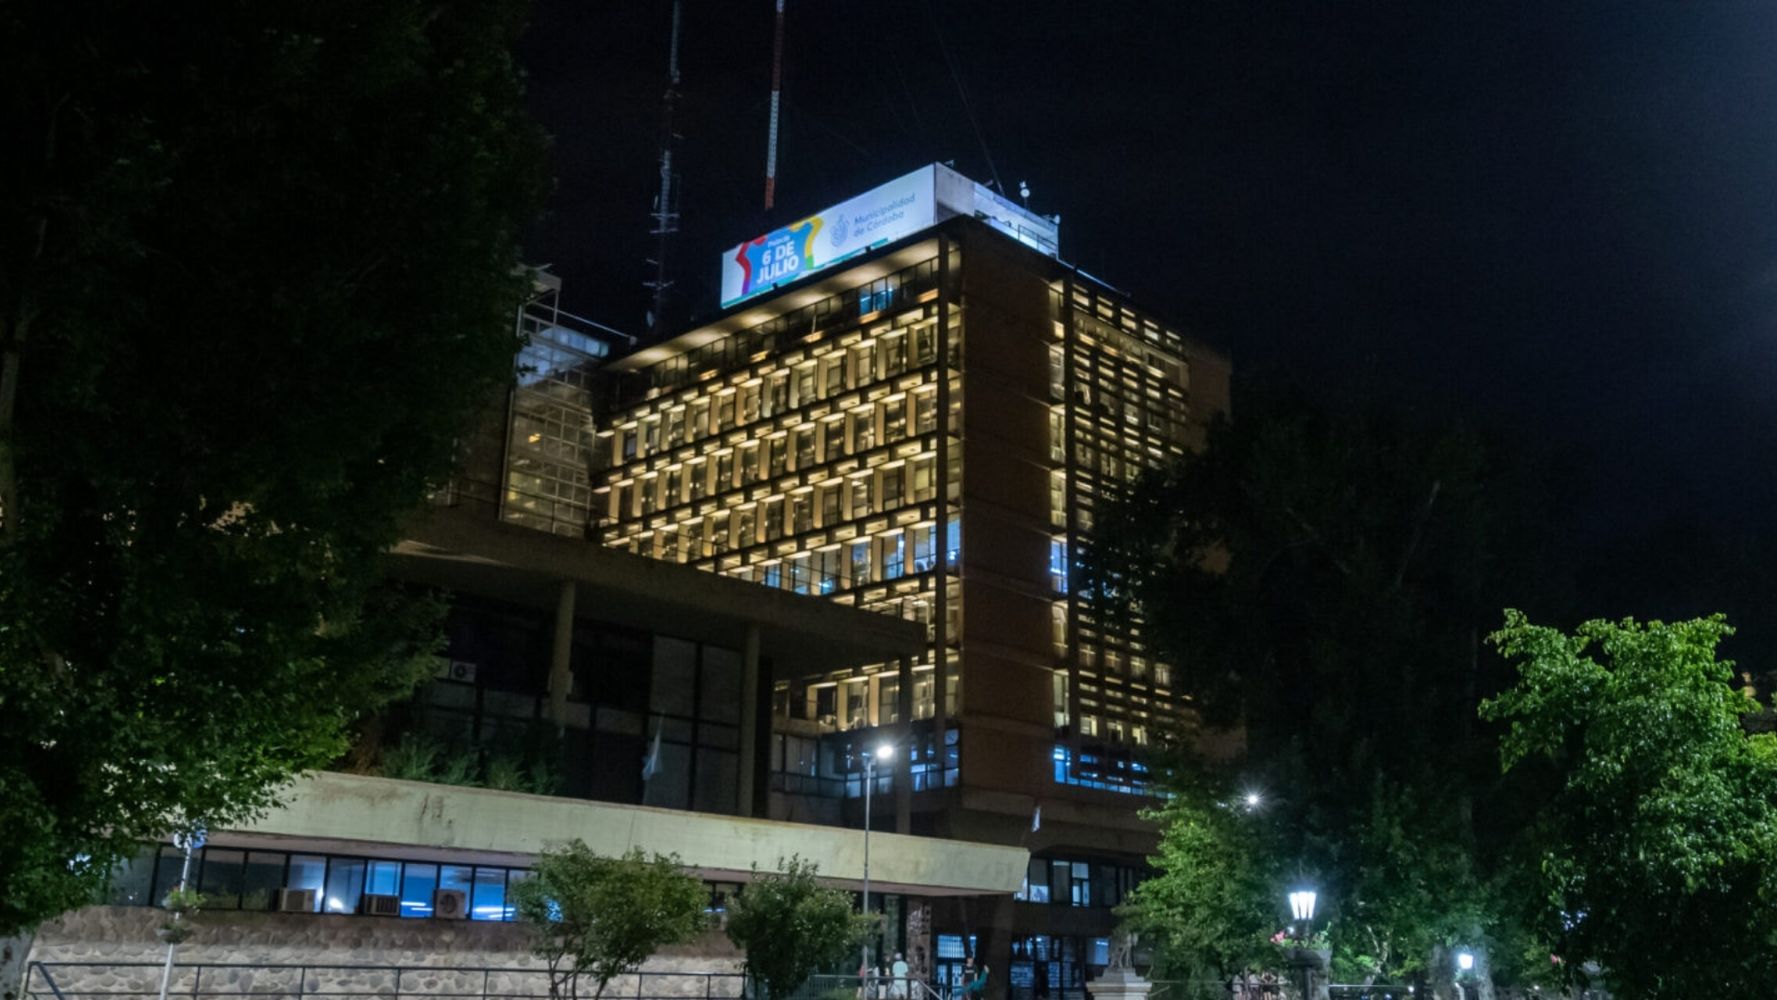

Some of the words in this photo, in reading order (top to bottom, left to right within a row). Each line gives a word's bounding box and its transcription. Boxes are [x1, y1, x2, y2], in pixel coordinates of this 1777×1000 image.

[854, 192, 915, 224] Municipalidad
[853, 227, 865, 237] de
[762, 249, 771, 266] 6
[775, 240, 795, 261] DE
[756, 254, 799, 284] JULIO
